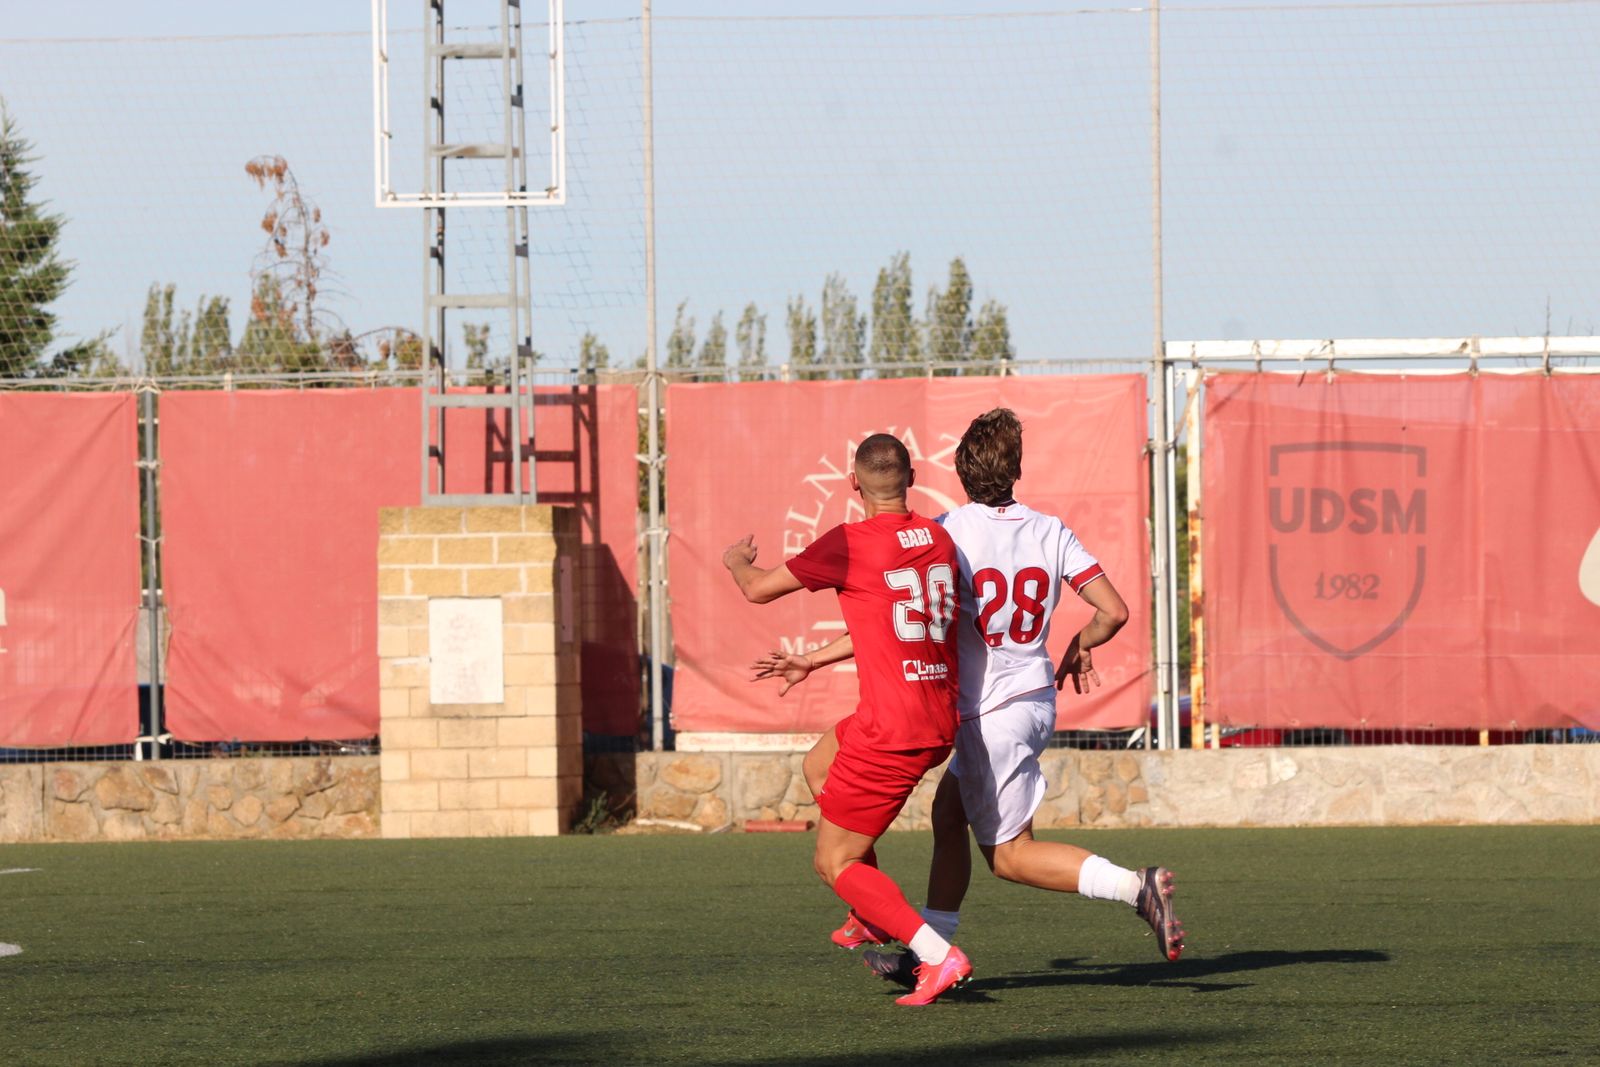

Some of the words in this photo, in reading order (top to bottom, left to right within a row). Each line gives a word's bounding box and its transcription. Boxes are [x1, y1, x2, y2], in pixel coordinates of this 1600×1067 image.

[1268, 487, 1427, 535] UDSM
[896, 527, 934, 549] GABI
[884, 563, 956, 643] 20
[972, 566, 1050, 648] 28
[1314, 570, 1381, 601] 1982
